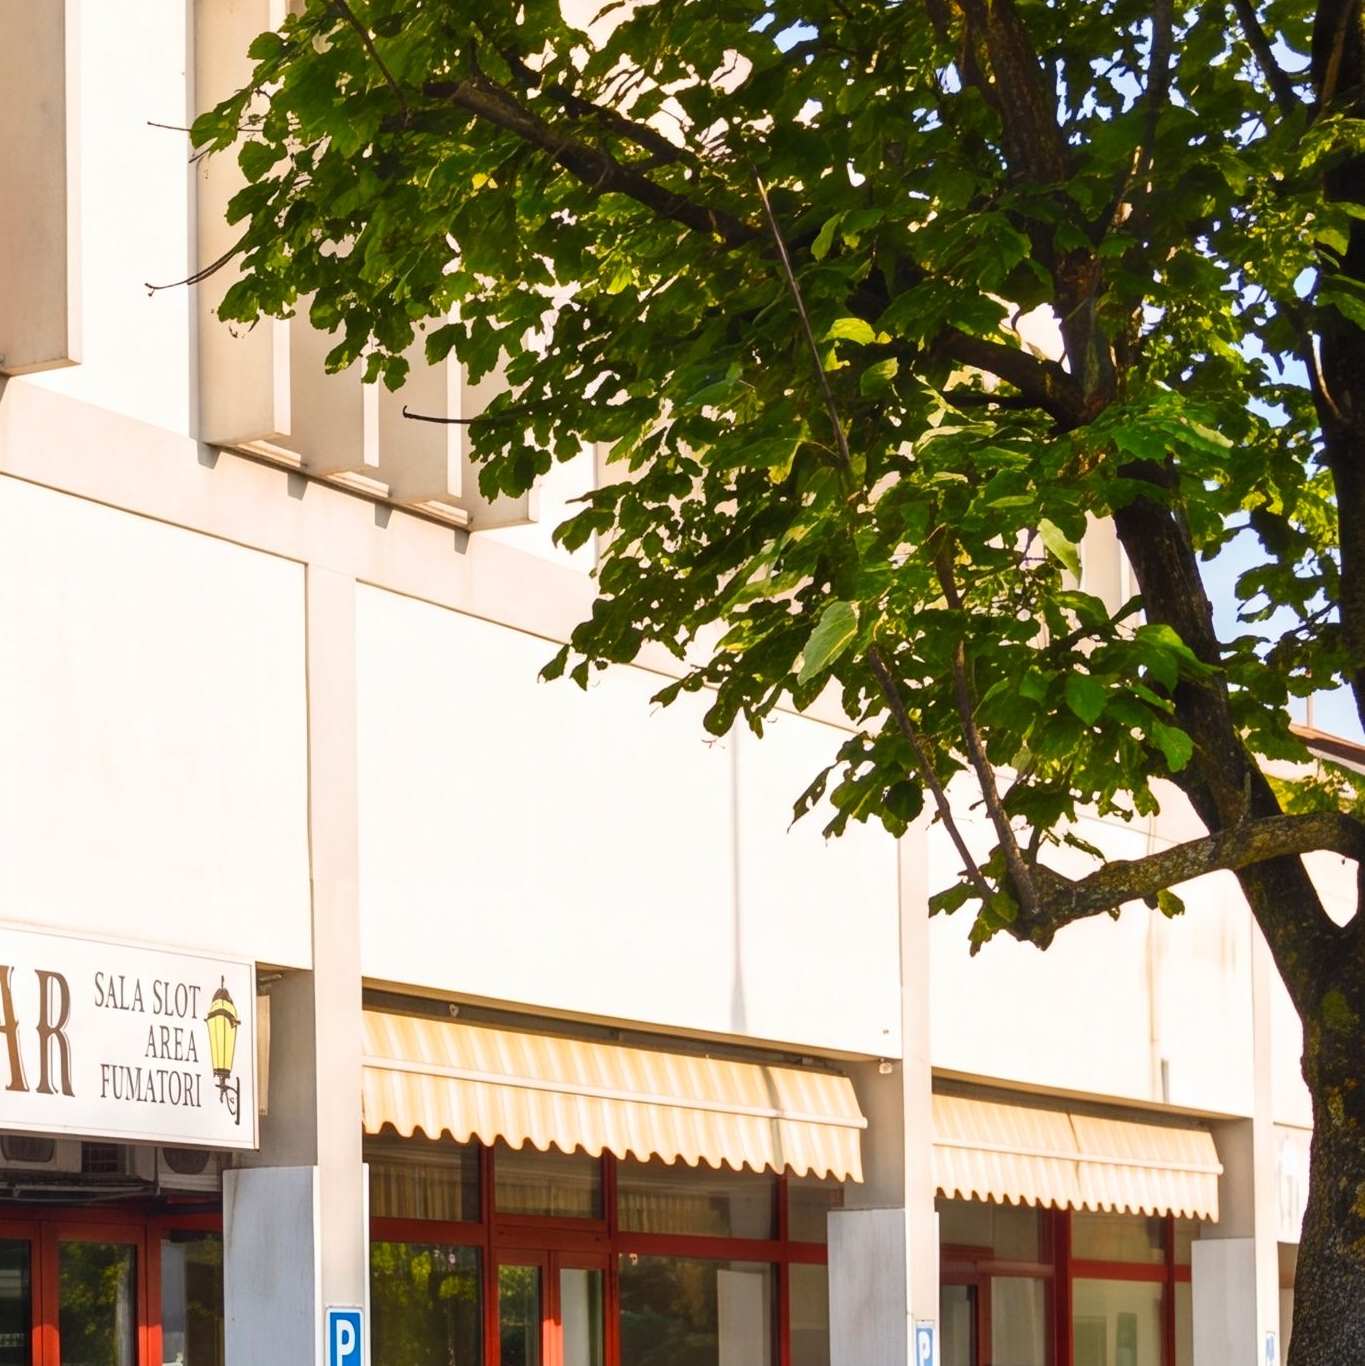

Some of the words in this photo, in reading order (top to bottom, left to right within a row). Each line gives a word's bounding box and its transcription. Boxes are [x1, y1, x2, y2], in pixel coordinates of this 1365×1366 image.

[94, 971, 145, 1013] SALA
[152, 979, 201, 1020] SLOT
[144, 1024, 199, 1063] AREA
[100, 1063, 202, 1108] FUMATORI
